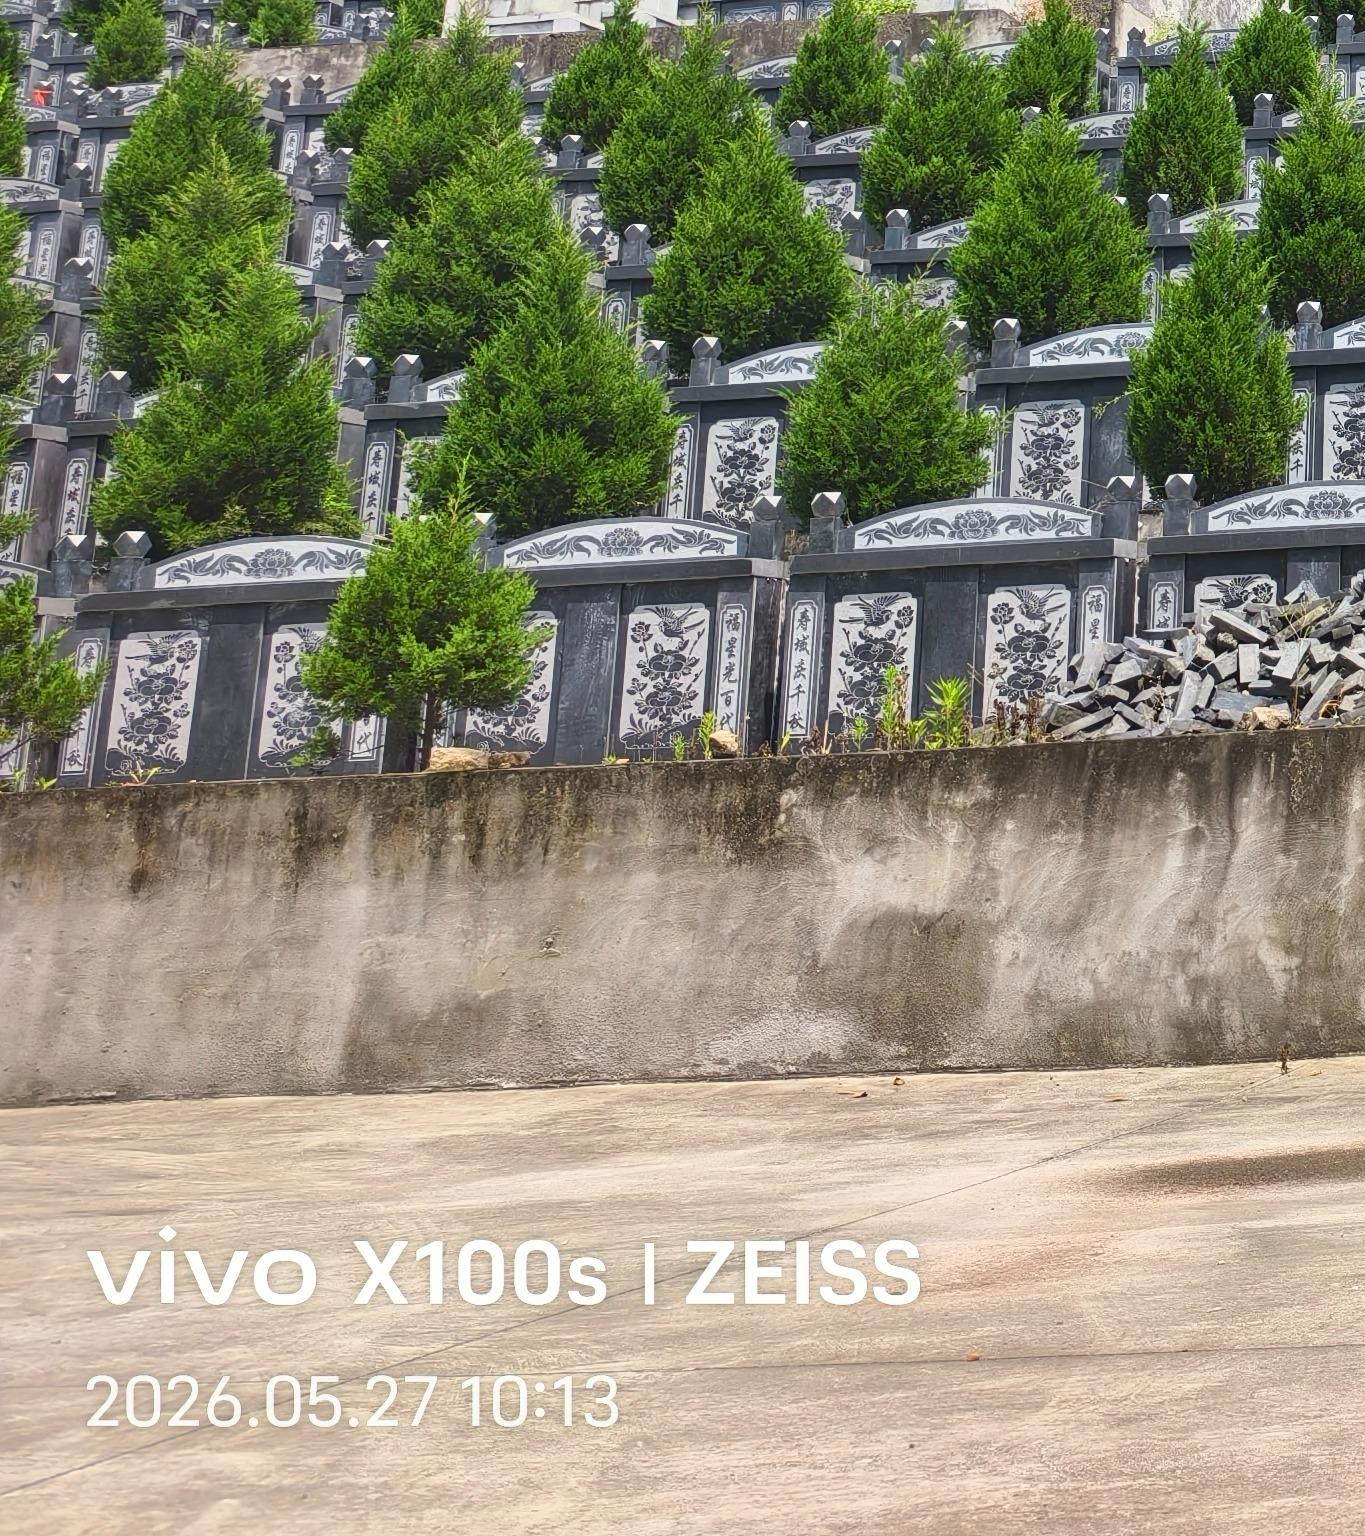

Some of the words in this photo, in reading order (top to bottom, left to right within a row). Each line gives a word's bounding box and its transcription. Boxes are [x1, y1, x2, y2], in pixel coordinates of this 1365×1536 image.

[719, 611, 743, 734] 福星光百代
[787, 606, 812, 731] 寿域庆千秋
